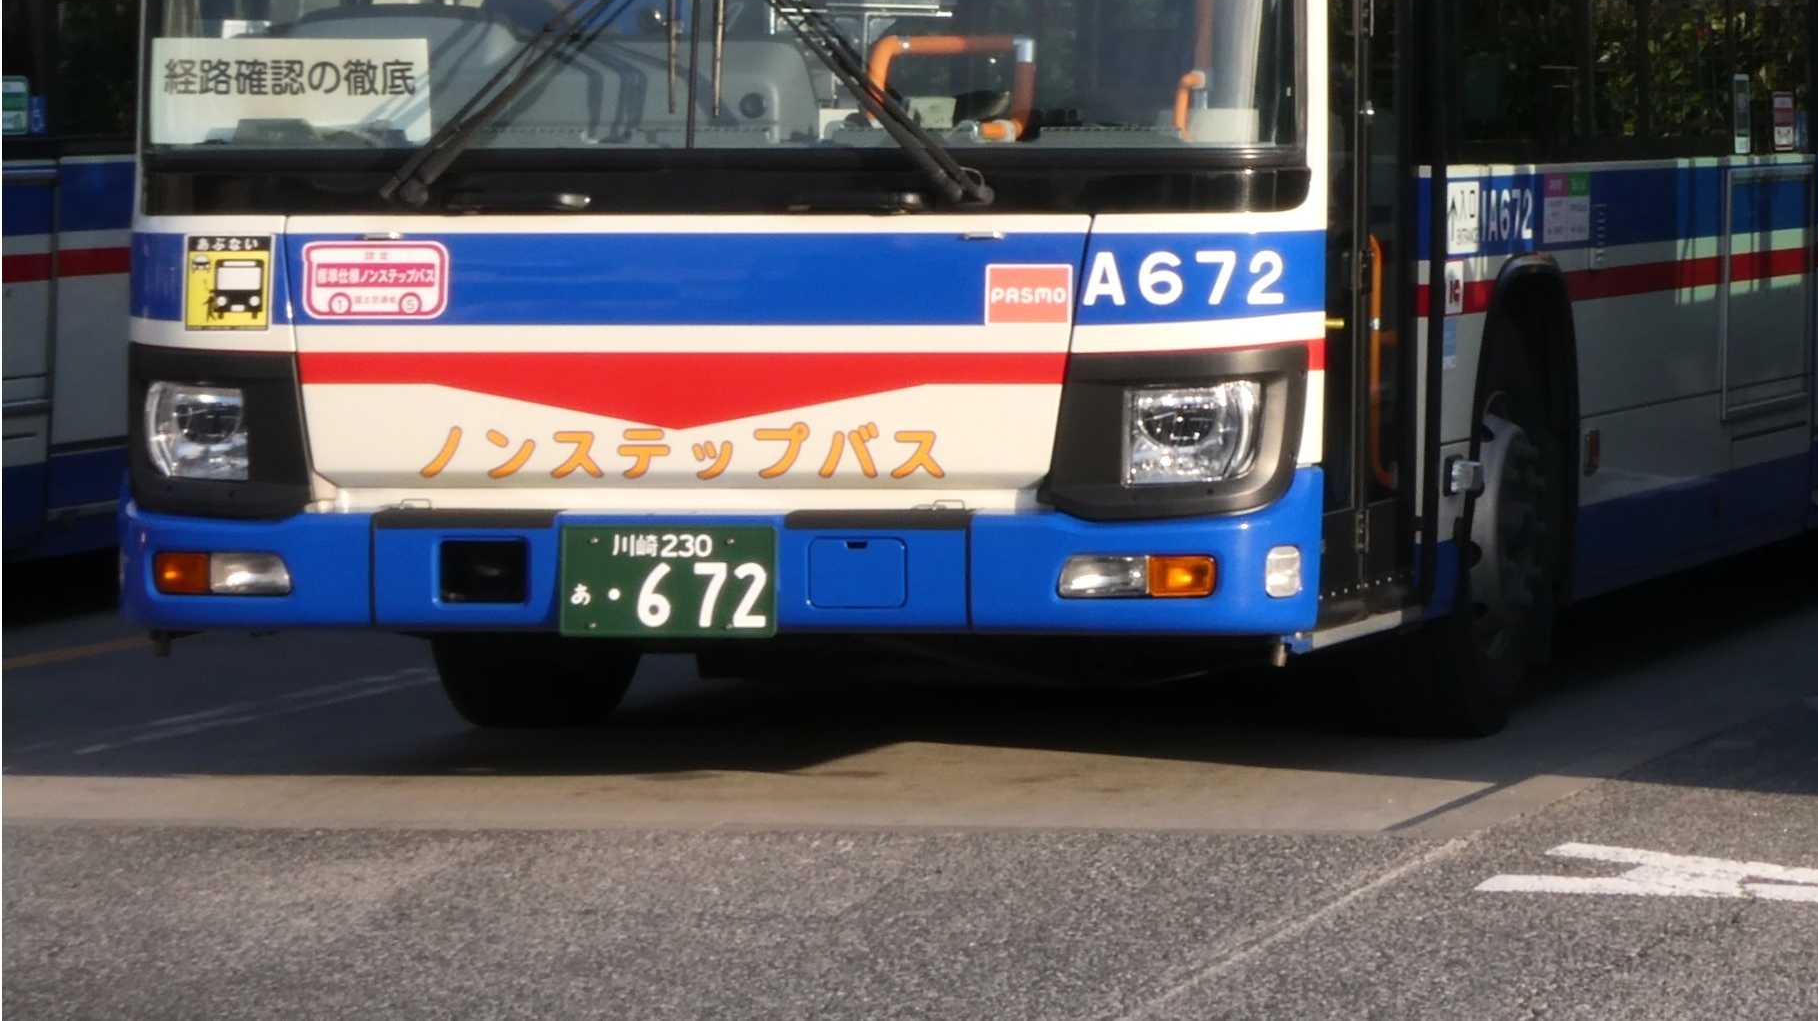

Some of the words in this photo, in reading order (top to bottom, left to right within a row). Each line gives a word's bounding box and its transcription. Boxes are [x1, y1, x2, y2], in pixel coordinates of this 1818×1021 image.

[164, 58, 416, 98] 経路確認の徹底
[196, 237, 259, 250] あぶない
[990, 285, 1068, 305] PASMO
[1083, 250, 1285, 306] A672
[419, 421, 946, 480] ノンステップバス
